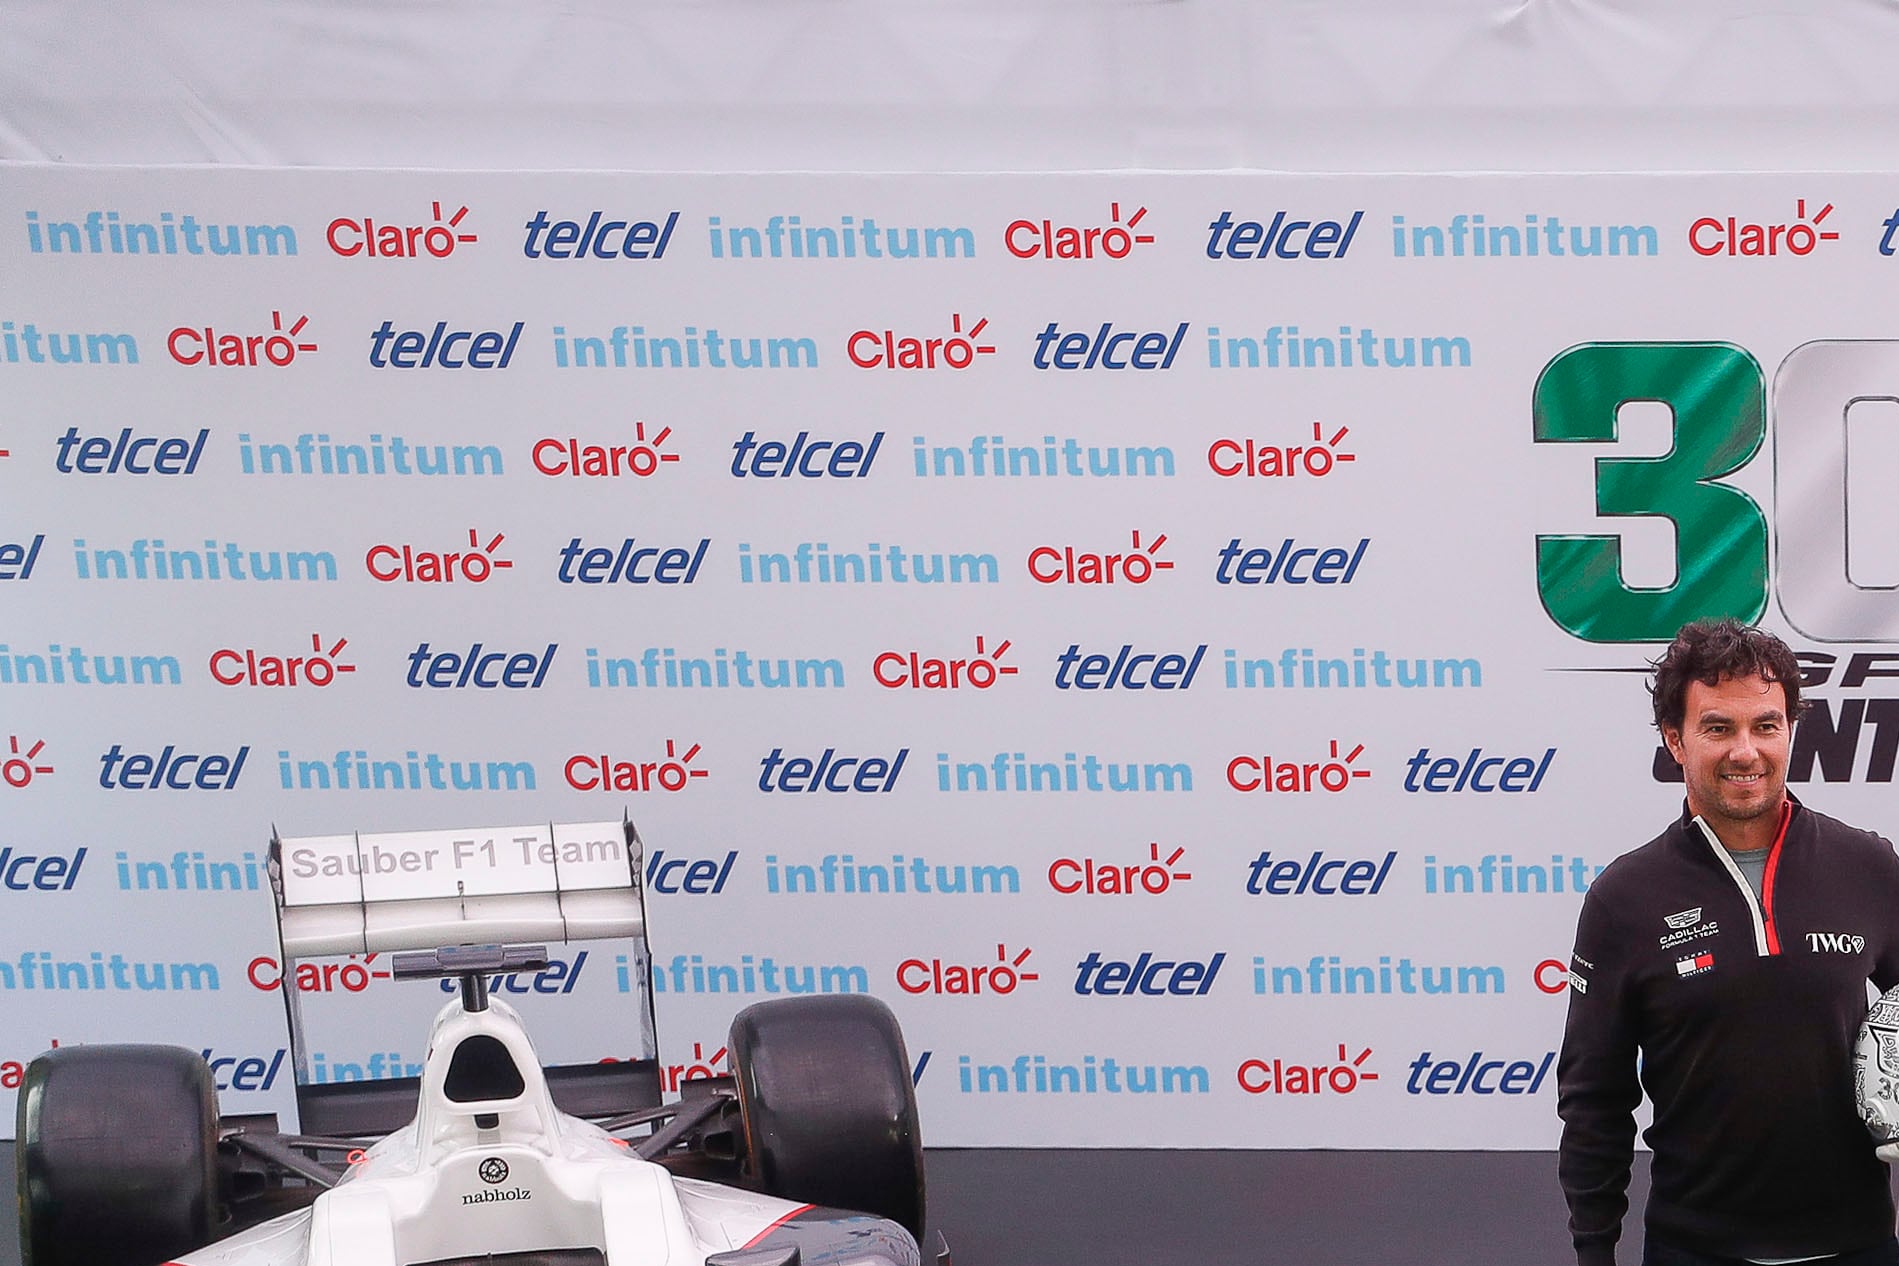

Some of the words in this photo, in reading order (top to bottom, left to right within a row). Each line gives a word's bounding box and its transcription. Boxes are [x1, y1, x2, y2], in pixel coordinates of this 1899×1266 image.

[25, 210, 299, 257] infinitum
[523, 210, 680, 260] telcel
[708, 215, 976, 260] infinitum
[1003, 217, 1136, 260] Claro
[1205, 210, 1364, 260] telcel
[1688, 215, 1820, 257] Claro
[166, 326, 299, 368] Claro
[369, 320, 524, 370] telcel
[552, 325, 819, 370] infinitum
[846, 328, 977, 370] Claro
[1207, 325, 1472, 369] infinitum
[55, 426, 210, 476] telcel
[238, 432, 504, 477] infinitum
[531, 436, 661, 478] Claro
[913, 434, 1176, 478] infinitum
[1207, 436, 1337, 478] Claro
[73, 537, 338, 582] infinitum
[365, 543, 494, 584] Claro
[557, 537, 711, 585] telcel
[738, 542, 1000, 585] infinitum
[1027, 545, 1156, 585] Claro
[208, 648, 337, 688] Claro
[406, 642, 558, 689] telcel
[585, 647, 846, 689] infinitum
[872, 650, 1000, 690] Claro
[1223, 647, 1483, 690] infinitum
[99, 744, 250, 791] telcel
[277, 749, 537, 792] infinitum
[563, 753, 691, 793] Claro
[758, 747, 909, 794] telcel
[1225, 753, 1353, 793] Claro
[1403, 747, 1557, 793] telcel
[291, 845, 440, 879] Sauber
[452, 838, 497, 869] F1
[511, 836, 622, 866] Team
[764, 853, 1021, 895] infinitum
[1047, 857, 1174, 896] Claro
[1245, 850, 1397, 896] telcel
[1658, 921, 1719, 945] CADILLAC
[1805, 932, 1852, 954] TWG
[895, 957, 1021, 996] Claro
[1073, 951, 1226, 996] telcel
[1252, 955, 1506, 996] infinitum
[958, 1054, 1211, 1095] infinitum
[1236, 1057, 1360, 1095] Claro
[1406, 1051, 1556, 1096] telcel
[461, 1185, 533, 1205] nabholz
